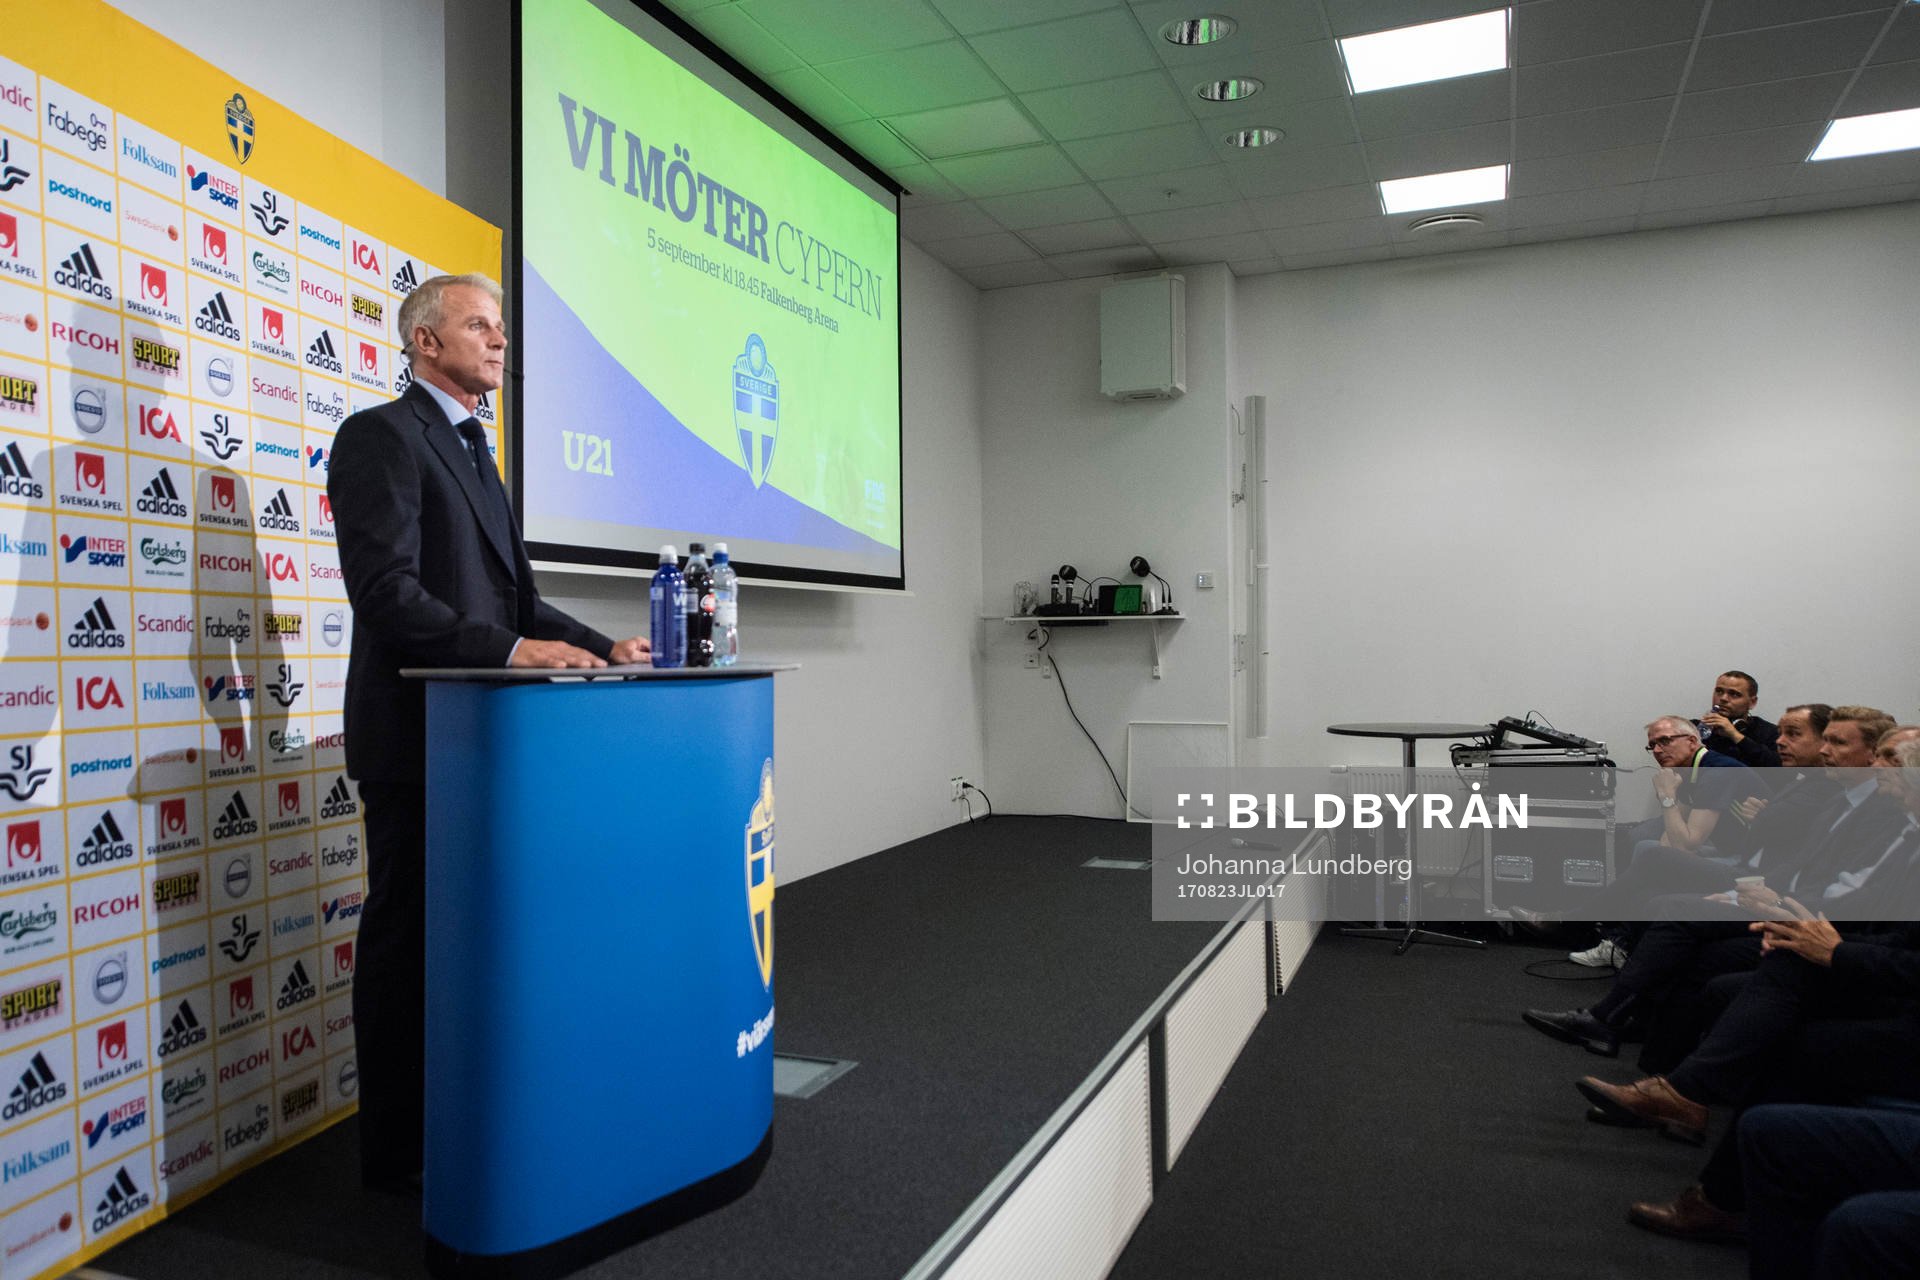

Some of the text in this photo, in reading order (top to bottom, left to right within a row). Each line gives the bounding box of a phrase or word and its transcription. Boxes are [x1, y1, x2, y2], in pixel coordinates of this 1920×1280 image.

[48, 102, 107, 151] Fabege
[122, 137, 177, 178] Folksam
[48, 179, 112, 213] postnord
[208, 174, 239, 197] INTER
[209, 187, 239, 211] SPORT
[263, 190, 276, 213] SJ
[558, 91, 882, 321] VI MÖTER CYPERN
[300, 225, 340, 250] postnord
[191, 257, 241, 283] SVENSKA SPEL
[253, 251, 290, 282] Carlsberg
[352, 239, 381, 276] ICA
[14, 264, 38, 279] SPEL
[648, 228, 839, 333] 5 september kl 18.45 Falkenberg Arena
[54, 269, 113, 300] adidas
[301, 279, 343, 307] RICOH
[127, 300, 182, 325] SVENSKA SPEL
[352, 294, 382, 322] SPORT
[52, 322, 119, 354] RICOH
[195, 316, 240, 341] adidas
[133, 336, 180, 370] SPORT
[252, 340, 296, 361] SVENSKA SPEL
[306, 351, 342, 374] adidas
[252, 377, 298, 403] Scandic
[351, 372, 374, 386] SVENSKA
[375, 377, 387, 390] SPEL
[306, 393, 343, 422] Fabege
[139, 404, 182, 443] ICA
[214, 413, 229, 436] SJ
[255, 441, 299, 458] postnord
[562, 430, 614, 477] U21
[60, 494, 123, 511] SVENSKA SPEL
[137, 496, 187, 518] adidas
[200, 513, 248, 527] SVENSKA SPEL
[259, 513, 300, 532] adidas
[88, 536, 125, 553] INTER
[310, 529, 335, 538] SVENSKA
[88, 552, 125, 567] SPORT
[140, 538, 187, 563] Carlsberg
[200, 554, 251, 573] RICOH
[265, 552, 299, 582] ICA
[310, 563, 343, 580] Scand
[138, 614, 194, 633] Scandic
[205, 616, 250, 643] Fabege
[264, 613, 302, 634] SPORT
[68, 629, 125, 648] adidas
[225, 675, 256, 689] INTER
[278, 664, 291, 684] SJ
[76, 676, 124, 711] ICA
[143, 682, 195, 700] Folksam
[226, 689, 255, 701] SPORT
[268, 729, 305, 750] Carlsberg
[10, 745, 32, 771] SJ
[70, 755, 132, 777] postnord
[209, 764, 256, 778] SVENSKA SPEL
[320, 801, 357, 820] adidas
[213, 820, 257, 840] adidas
[269, 816, 311, 832] SVENSKA SPEL
[76, 842, 133, 868] adidas
[147, 837, 201, 856] SVENSKA SPEL
[322, 846, 358, 867] Fabege
[38, 864, 60, 877] SPEL
[269, 852, 313, 876] Scandic
[154, 871, 199, 903] SPORT
[74, 893, 139, 925] RICOH
[337, 892, 361, 908] INTER
[339, 904, 361, 920] SPORT
[0, 908, 57, 937] Carlsberg
[232, 914, 247, 937] SJ
[273, 913, 314, 937] Folksam
[152, 944, 205, 974] postnord
[1, 979, 61, 1021] SPORT
[276, 985, 315, 1010] adidas
[219, 1016, 249, 1035] SVENSKA
[157, 1026, 206, 1058] adidas
[282, 1024, 315, 1061] ICA
[82, 1059, 143, 1091] SVENSKA SPEL
[219, 1049, 270, 1083] RICOH
[162, 1067, 206, 1104] Carlsberg
[2, 1082, 66, 1120] adidas
[108, 1096, 146, 1123] INTER
[110, 1111, 146, 1139] SPORT
[224, 1116, 269, 1150] Fabege
[2, 1140, 70, 1183] Folksam
[159, 1140, 214, 1180] Scandic
[92, 1193, 149, 1234] adidas
